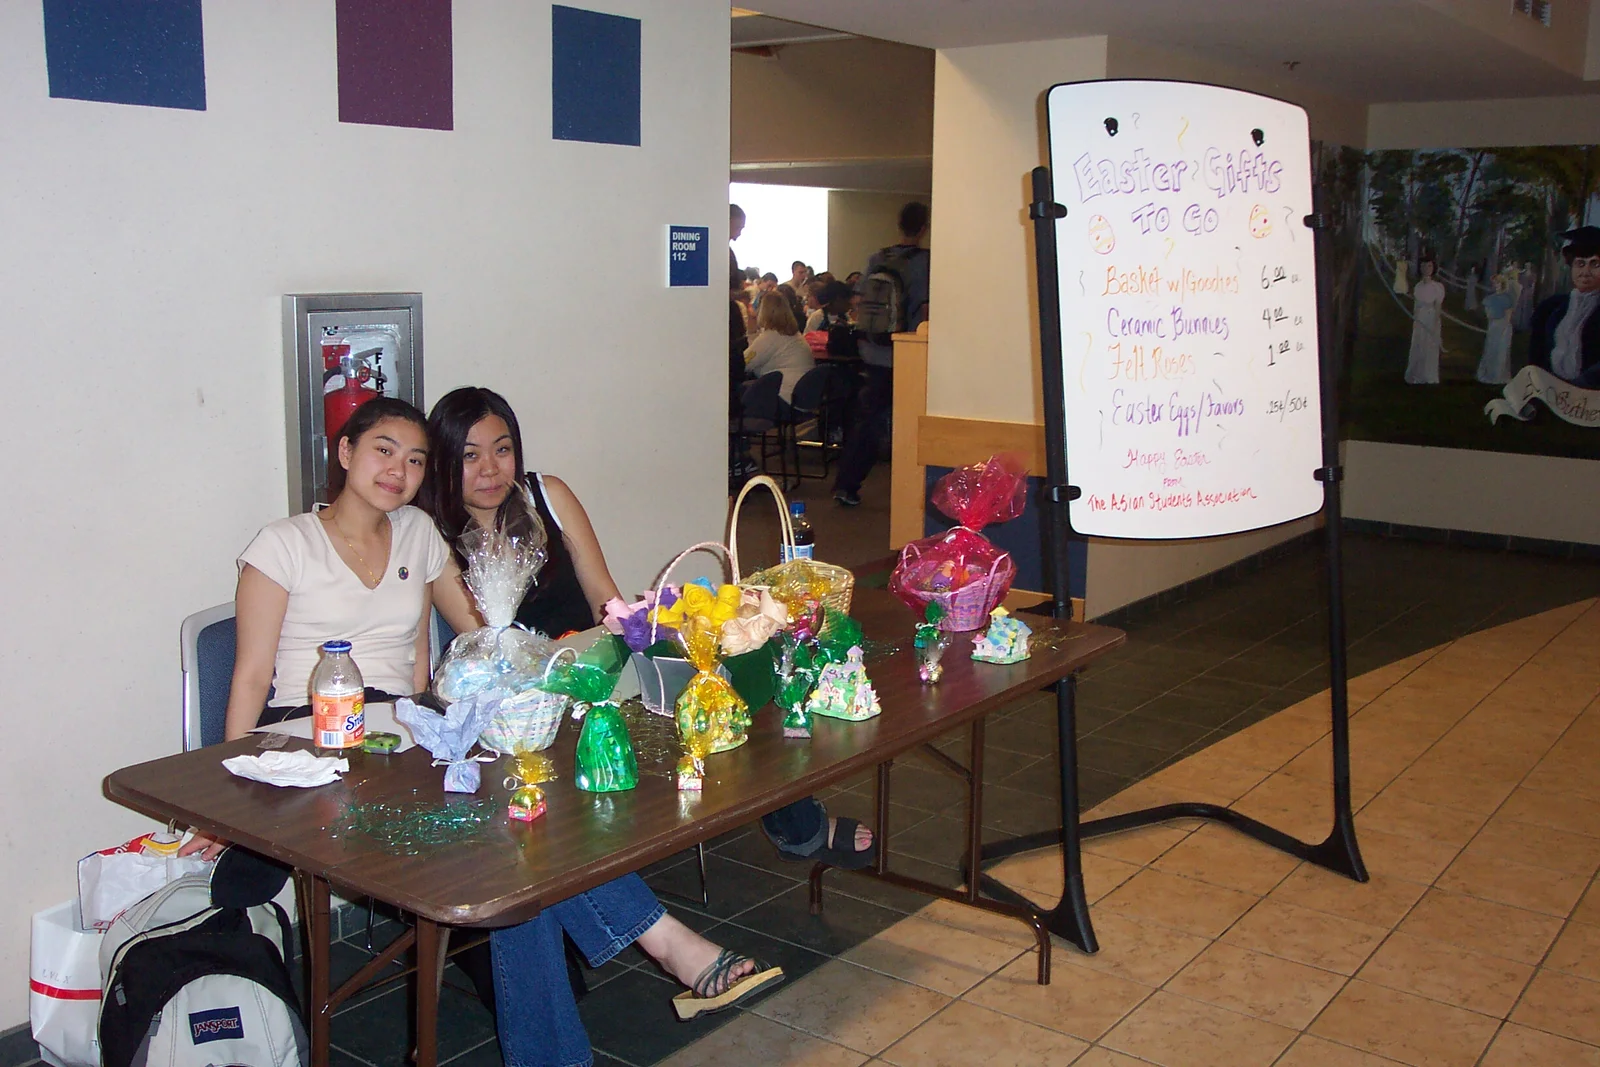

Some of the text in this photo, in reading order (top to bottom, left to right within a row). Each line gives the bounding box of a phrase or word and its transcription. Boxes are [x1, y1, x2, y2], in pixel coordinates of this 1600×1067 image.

[1074, 147, 1284, 203] Easter Gifts
[672, 232, 701, 241] DINING
[672, 242, 696, 251] ROOM
[672, 252, 687, 261] 112
[1101, 264, 1163, 297] Basket
[1107, 307, 1166, 338] Ceramic
[1170, 305, 1230, 341] Bunnies
[1107, 342, 1149, 381] Felt
[1151, 346, 1197, 381] Roses
[1112, 388, 1164, 425] Easter
[1122, 448, 1165, 474] Happy
[1088, 493, 1106, 512] The
[1111, 493, 1145, 512] Asian
[1197, 487, 1257, 507] Association
[193, 1018, 240, 1037] JANSPORT
